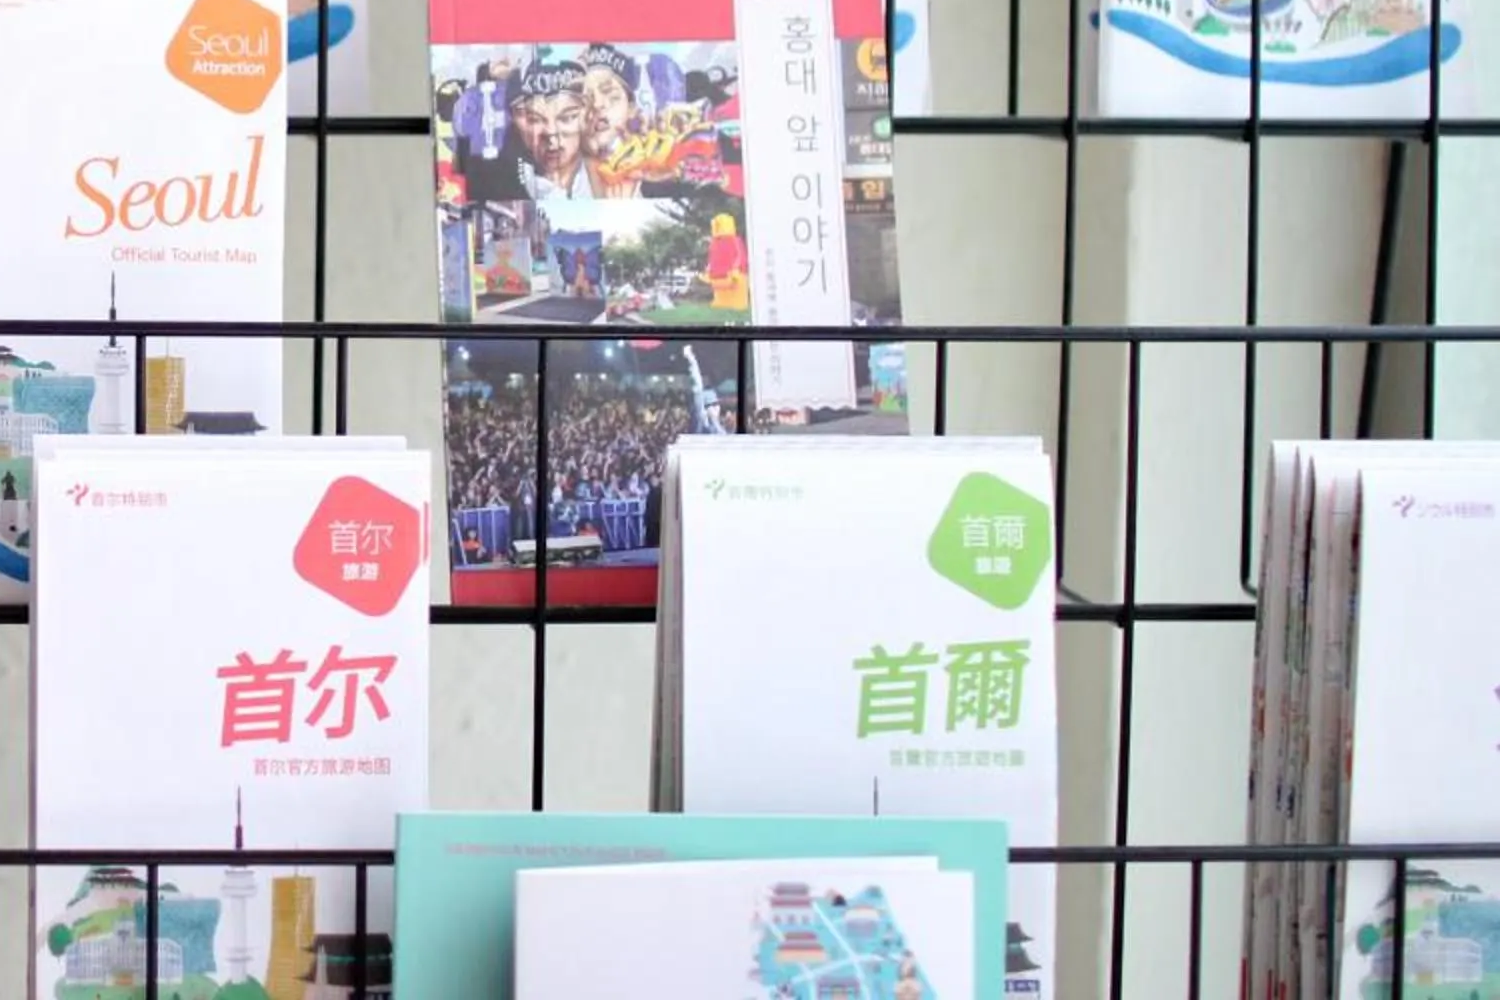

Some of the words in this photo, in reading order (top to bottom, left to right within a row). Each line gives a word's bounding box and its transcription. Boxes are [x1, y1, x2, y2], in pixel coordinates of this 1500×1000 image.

[188, 26, 269, 57] Seoul
[781, 14, 817, 95] 홍대
[192, 61, 266, 77] Attraction
[787, 114, 821, 152] 앞
[64, 134, 264, 239] Seoul
[791, 172, 828, 294] 이야기
[111, 247, 165, 263] Official
[172, 248, 220, 263] Tourist
[226, 248, 258, 266] Map
[328, 520, 394, 556] 首尔
[959, 514, 1027, 550] 首爾
[217, 644, 398, 748] 首尔
[852, 639, 1031, 739] 首爾
